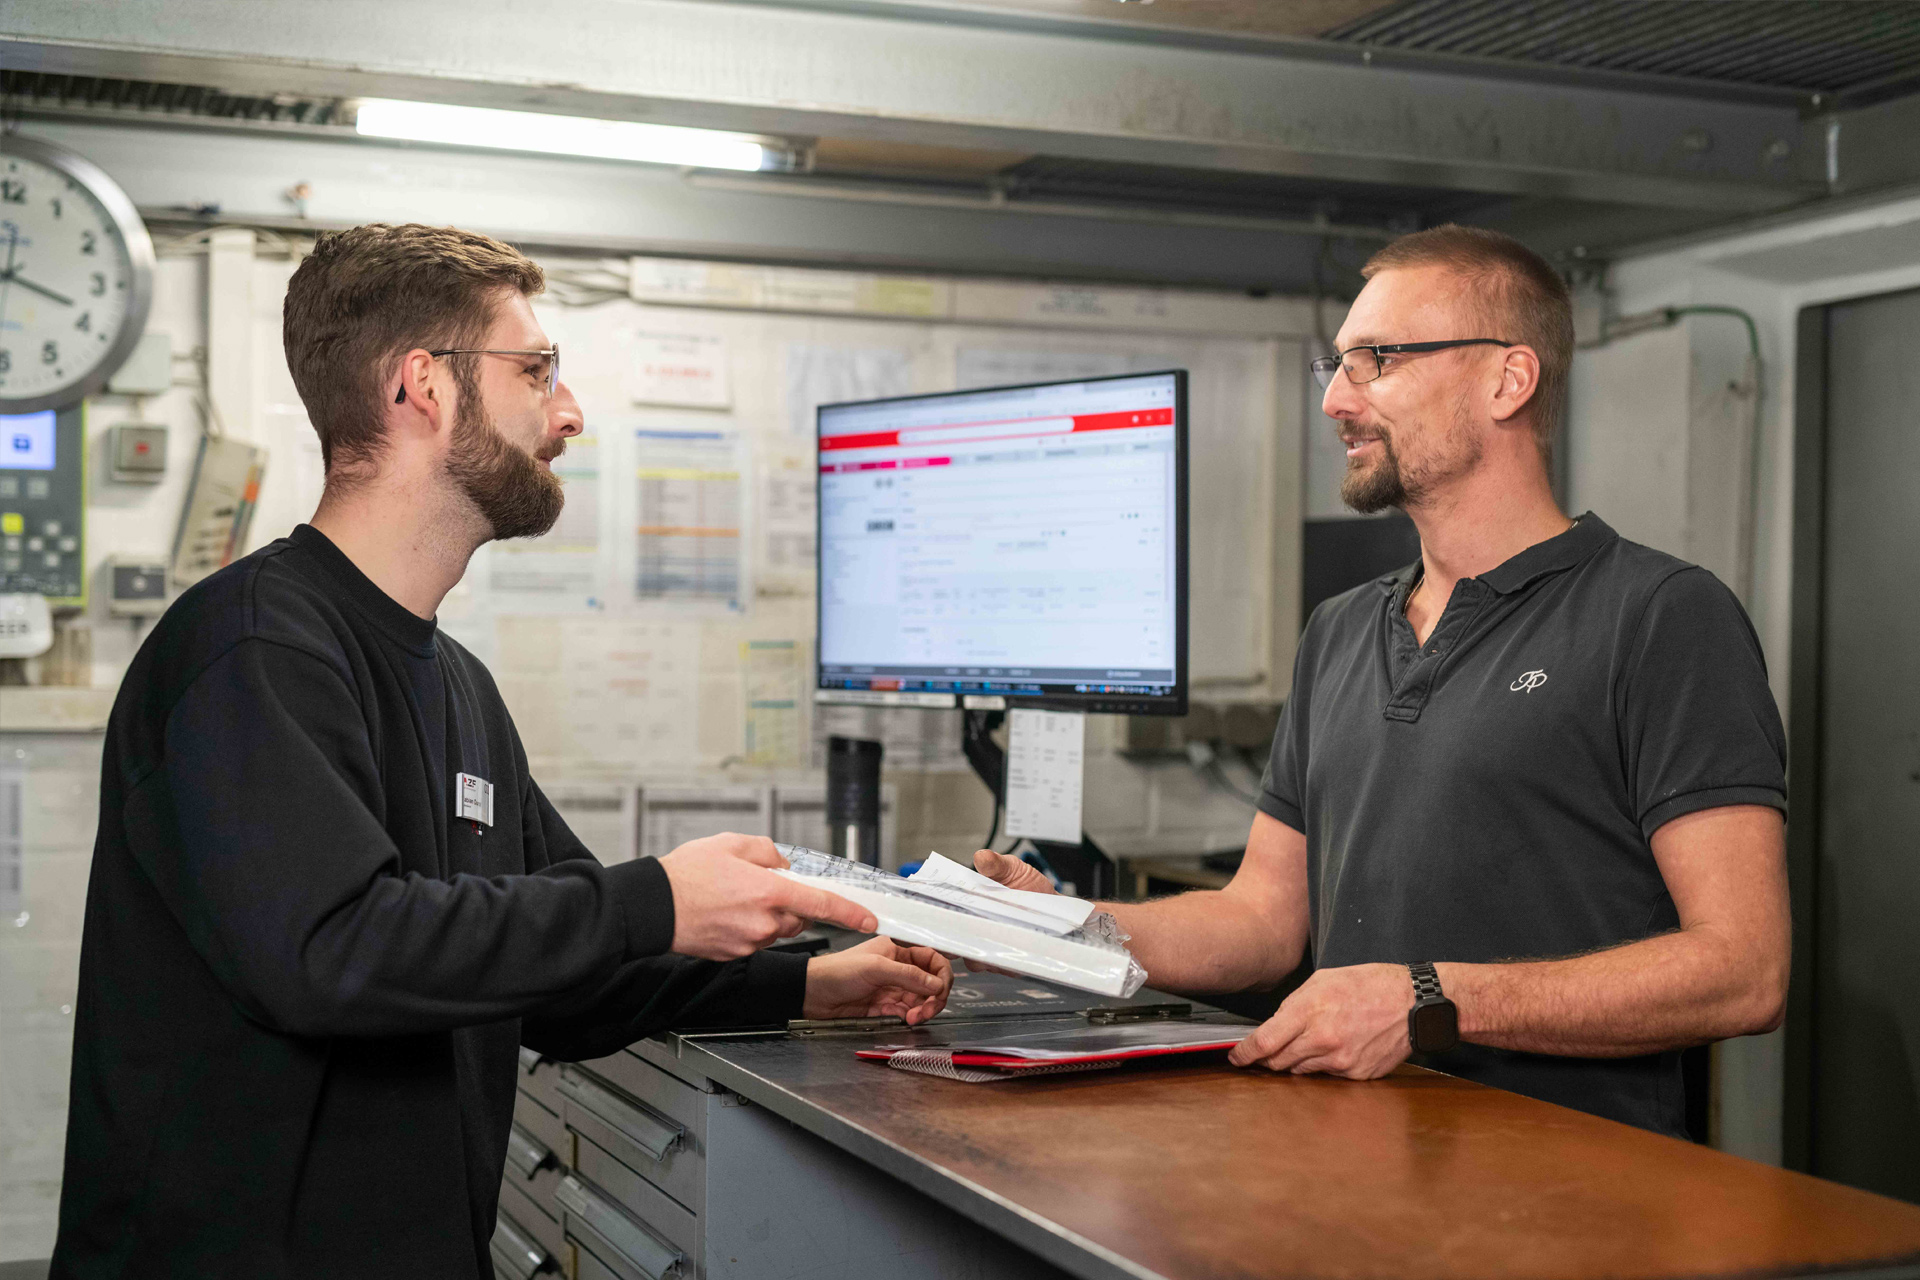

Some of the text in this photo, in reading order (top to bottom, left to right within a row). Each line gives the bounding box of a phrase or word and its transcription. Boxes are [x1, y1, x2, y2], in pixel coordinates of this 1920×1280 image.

[1, 180, 26, 203] 12
[52, 200, 61, 218] 1
[80, 231, 95, 254] 2
[91, 273, 106, 297] 3
[75, 312, 90, 332] 4
[43, 341, 57, 364] 5
